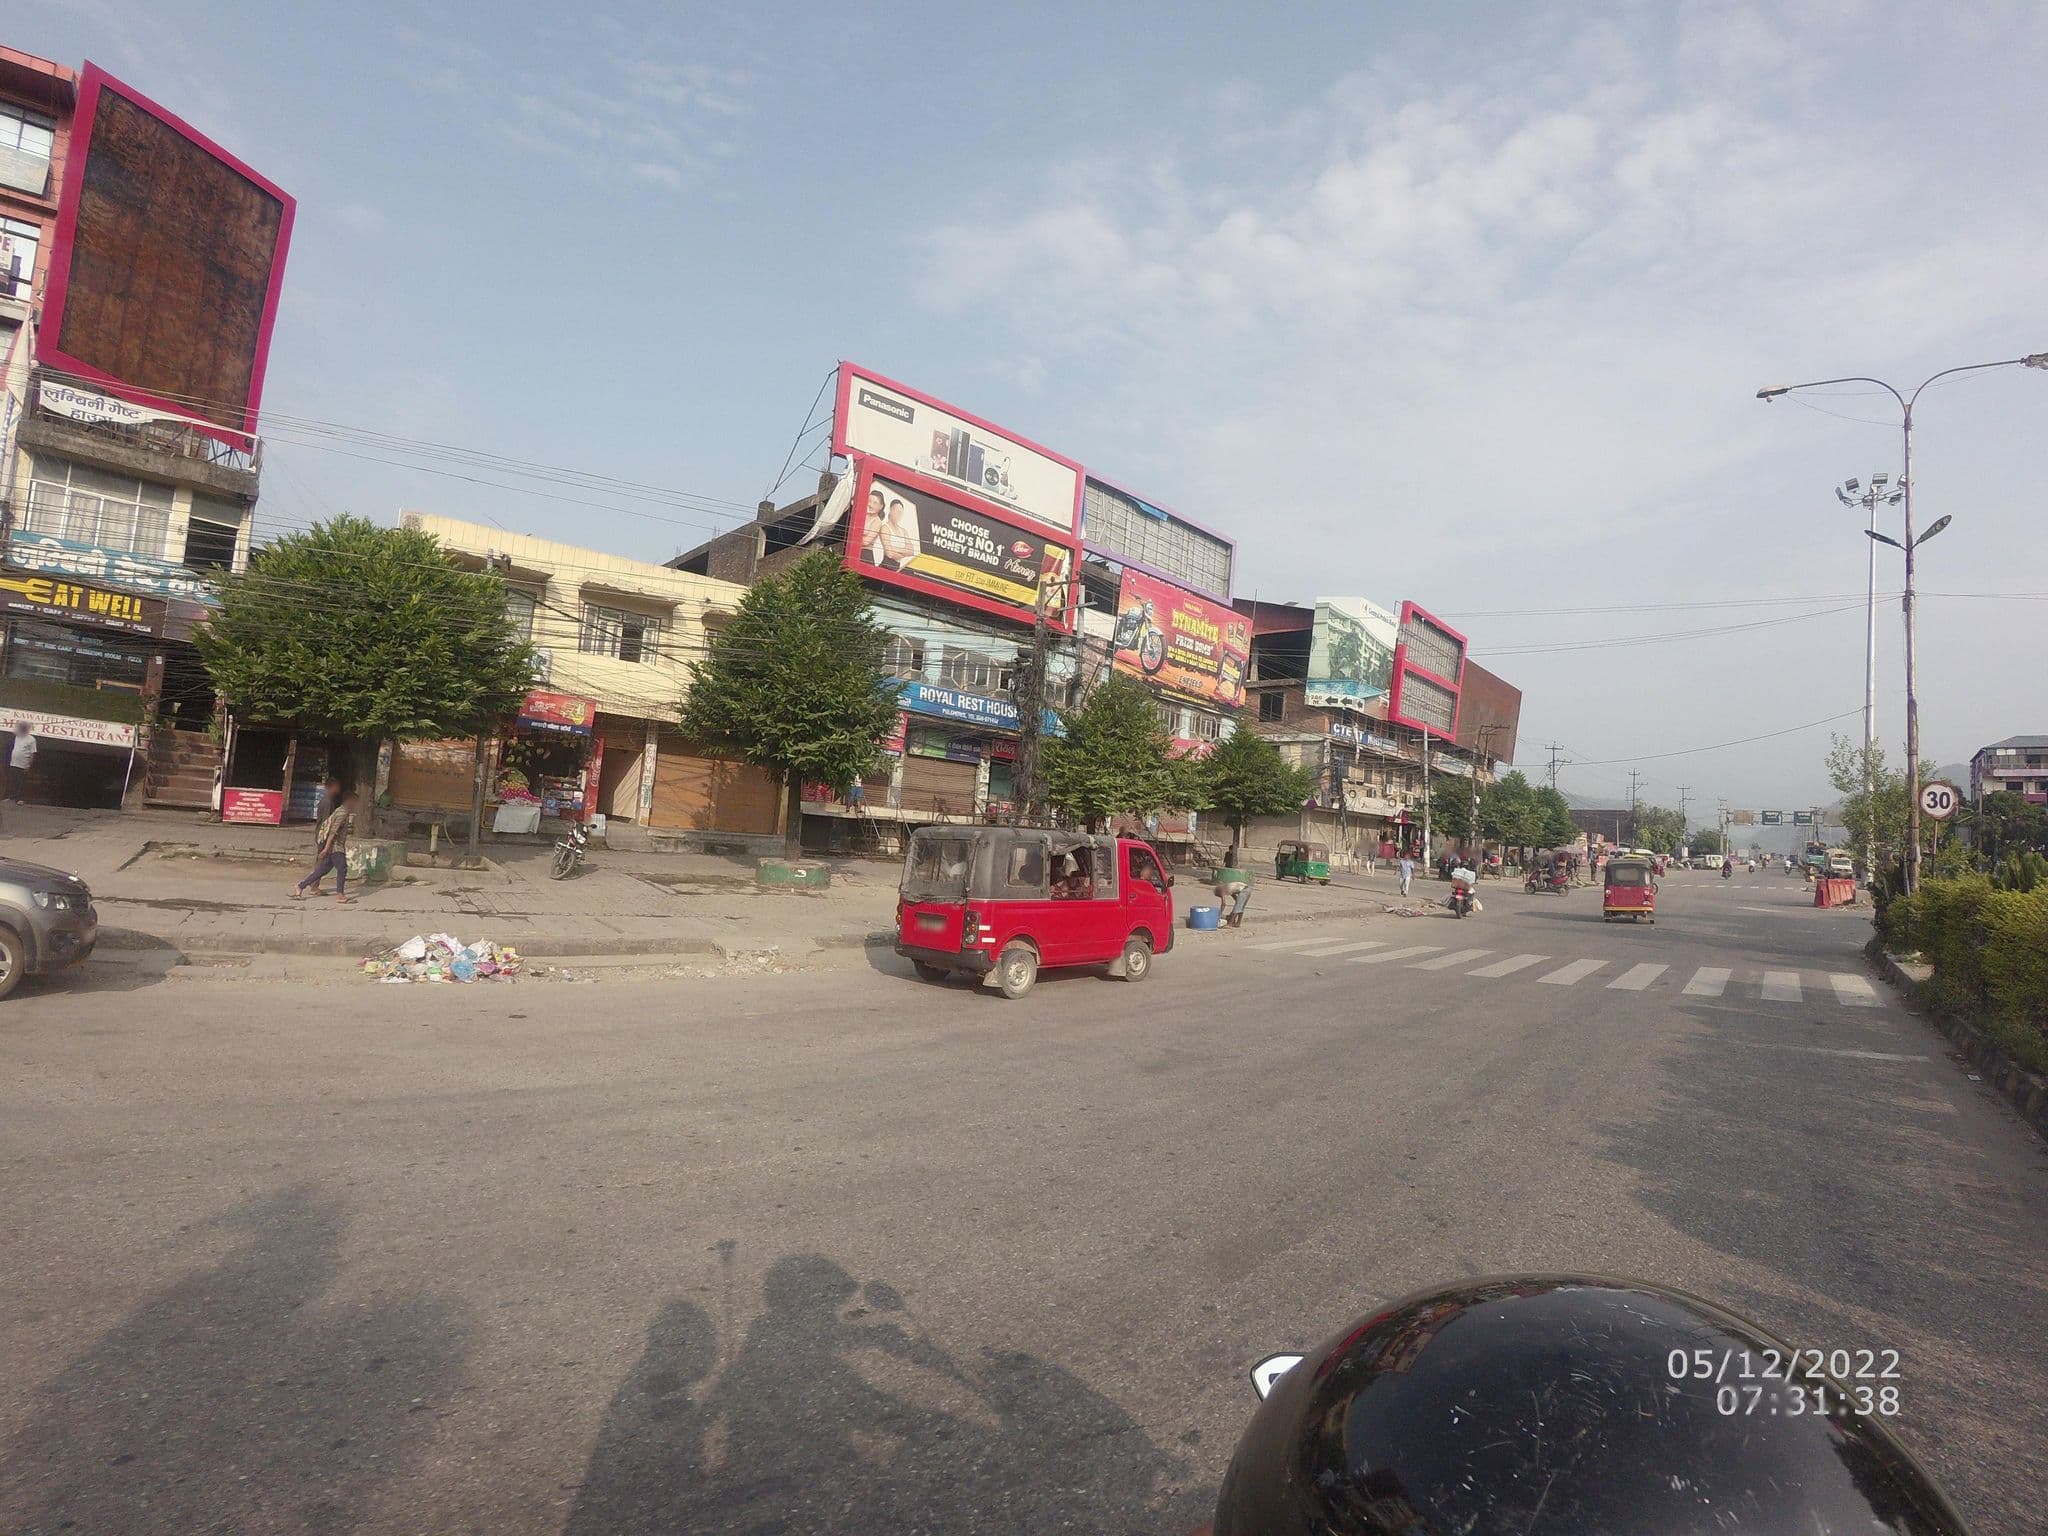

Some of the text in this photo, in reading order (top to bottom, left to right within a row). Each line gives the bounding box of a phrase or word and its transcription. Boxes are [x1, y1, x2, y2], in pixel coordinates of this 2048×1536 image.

[863, 393, 910, 418] Panasonic
[931, 523, 974, 547] WORLD'S
[951, 518, 990, 539] CHOOSE
[933, 536, 999, 566] HONEY BRAND
[88, 589, 142, 622] WELL
[1172, 608, 1219, 644] DYNAMITE
[919, 686, 955, 706] ROYAL
[957, 694, 985, 713] REST
[42, 722, 135, 744] RESTAURANT
[1926, 791, 1951, 809] 30
